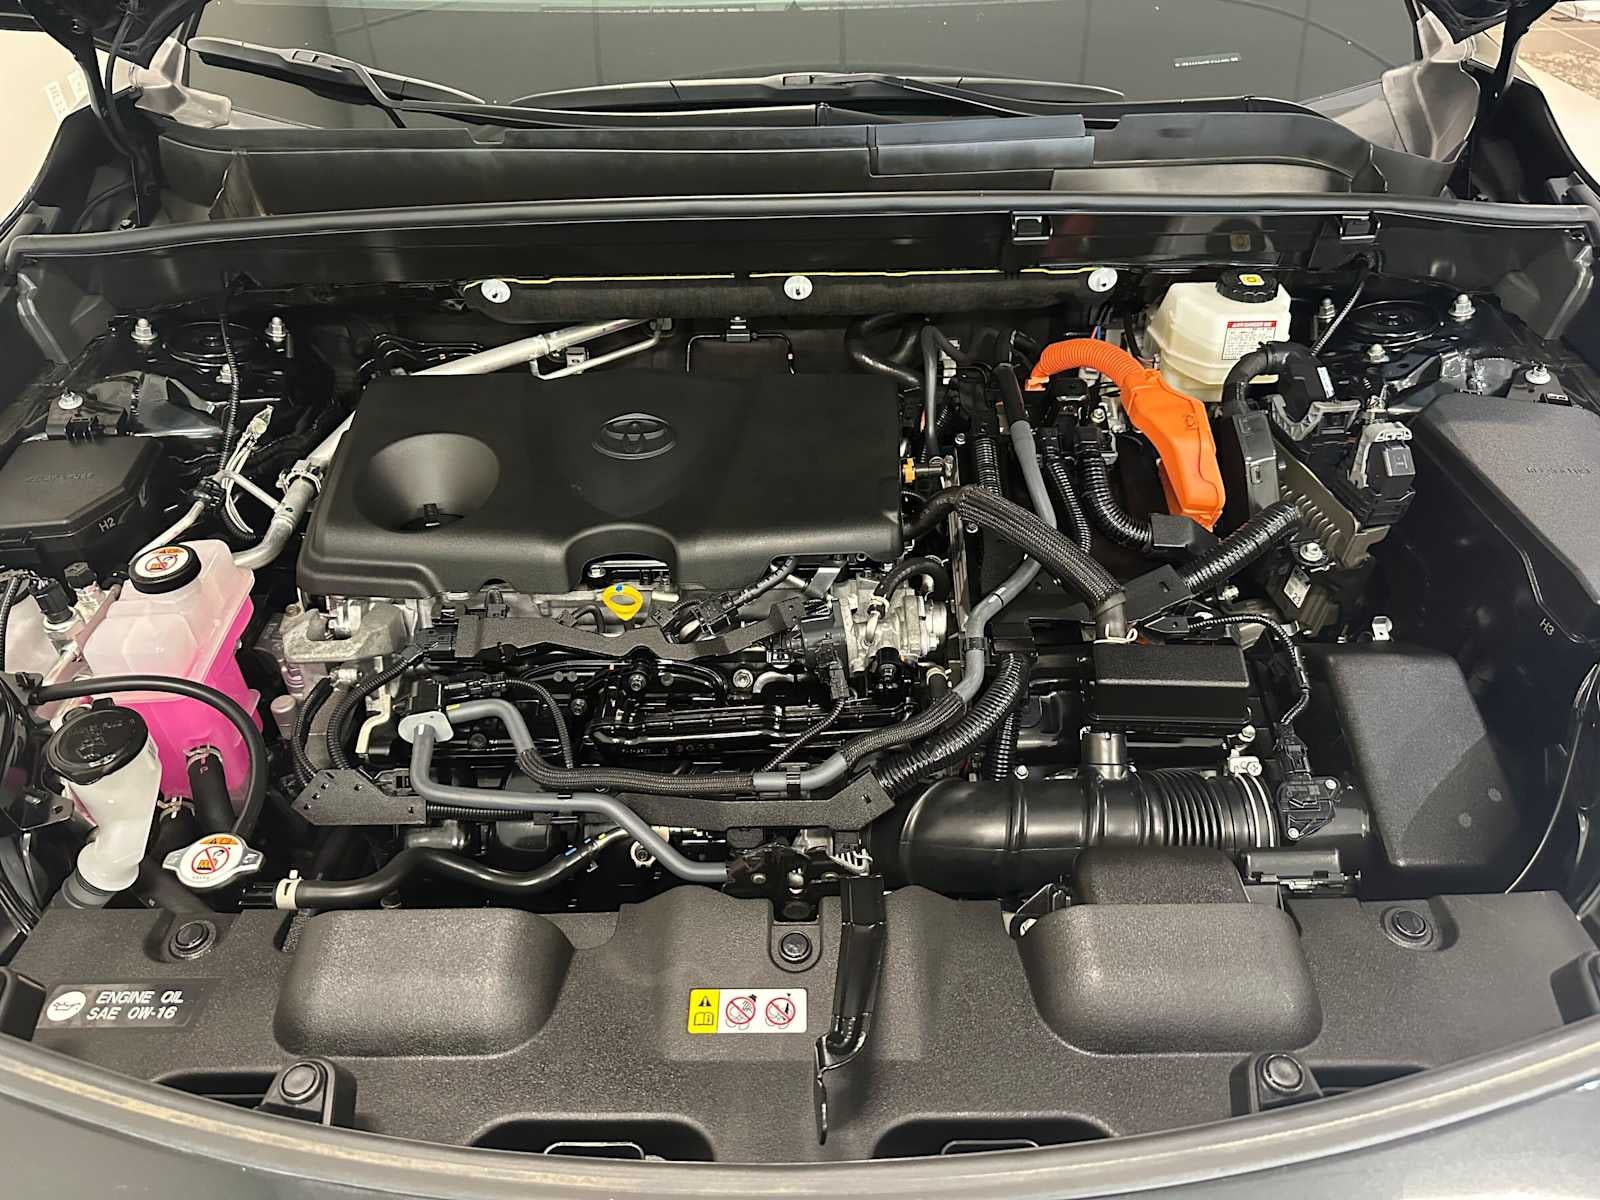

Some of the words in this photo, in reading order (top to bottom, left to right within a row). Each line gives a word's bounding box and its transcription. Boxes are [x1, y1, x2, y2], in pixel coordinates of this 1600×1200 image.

[98, 517, 116, 532] H2
[1539, 618, 1555, 635] H3
[96, 991, 155, 1004] ENGINE
[160, 991, 184, 1004] OIL
[86, 1006, 122, 1020] SAE
[127, 1006, 178, 1020] 0W-16
